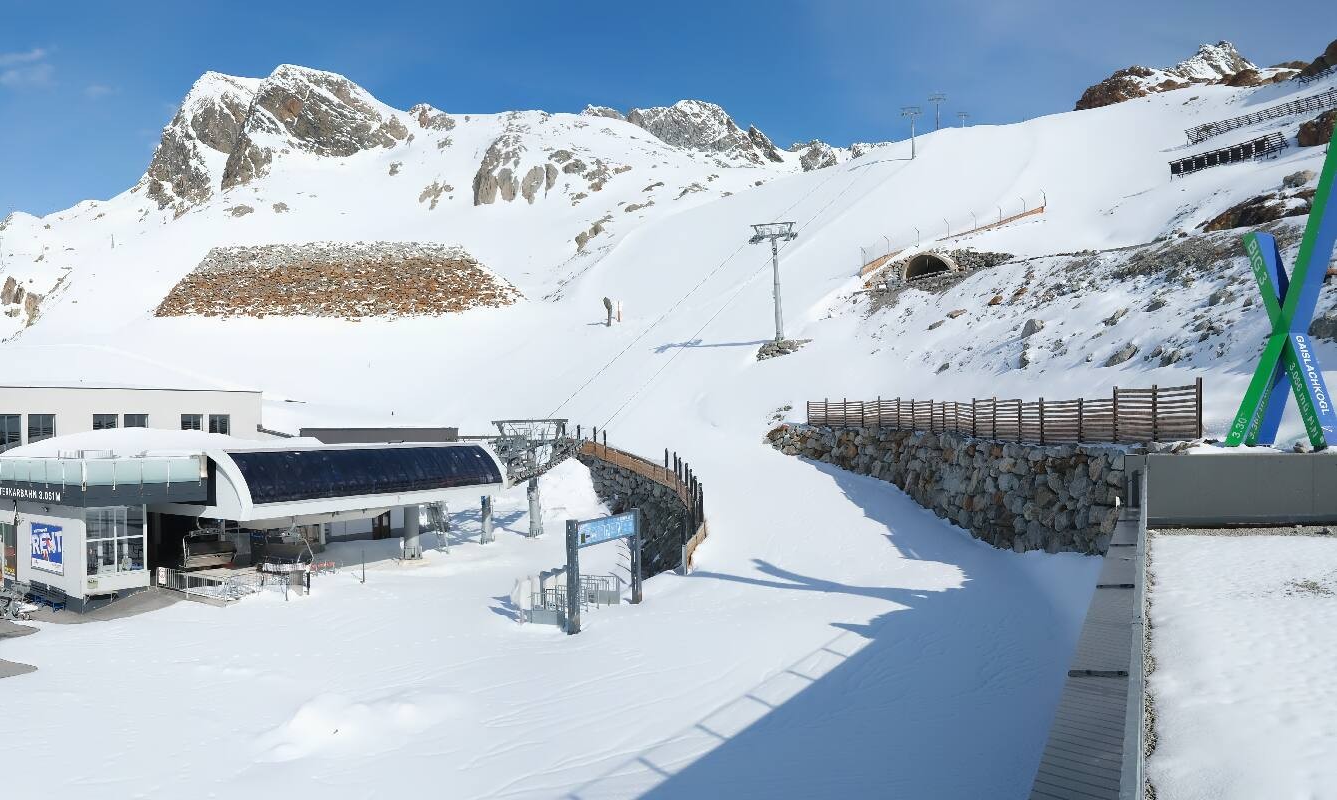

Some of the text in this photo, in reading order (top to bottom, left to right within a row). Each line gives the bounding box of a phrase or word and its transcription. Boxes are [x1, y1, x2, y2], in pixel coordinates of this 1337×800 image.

[1248, 238, 1268, 286] BIG 3
[1295, 335, 1330, 416] GAISLACHKOGL
[31, 531, 62, 555] RENT
